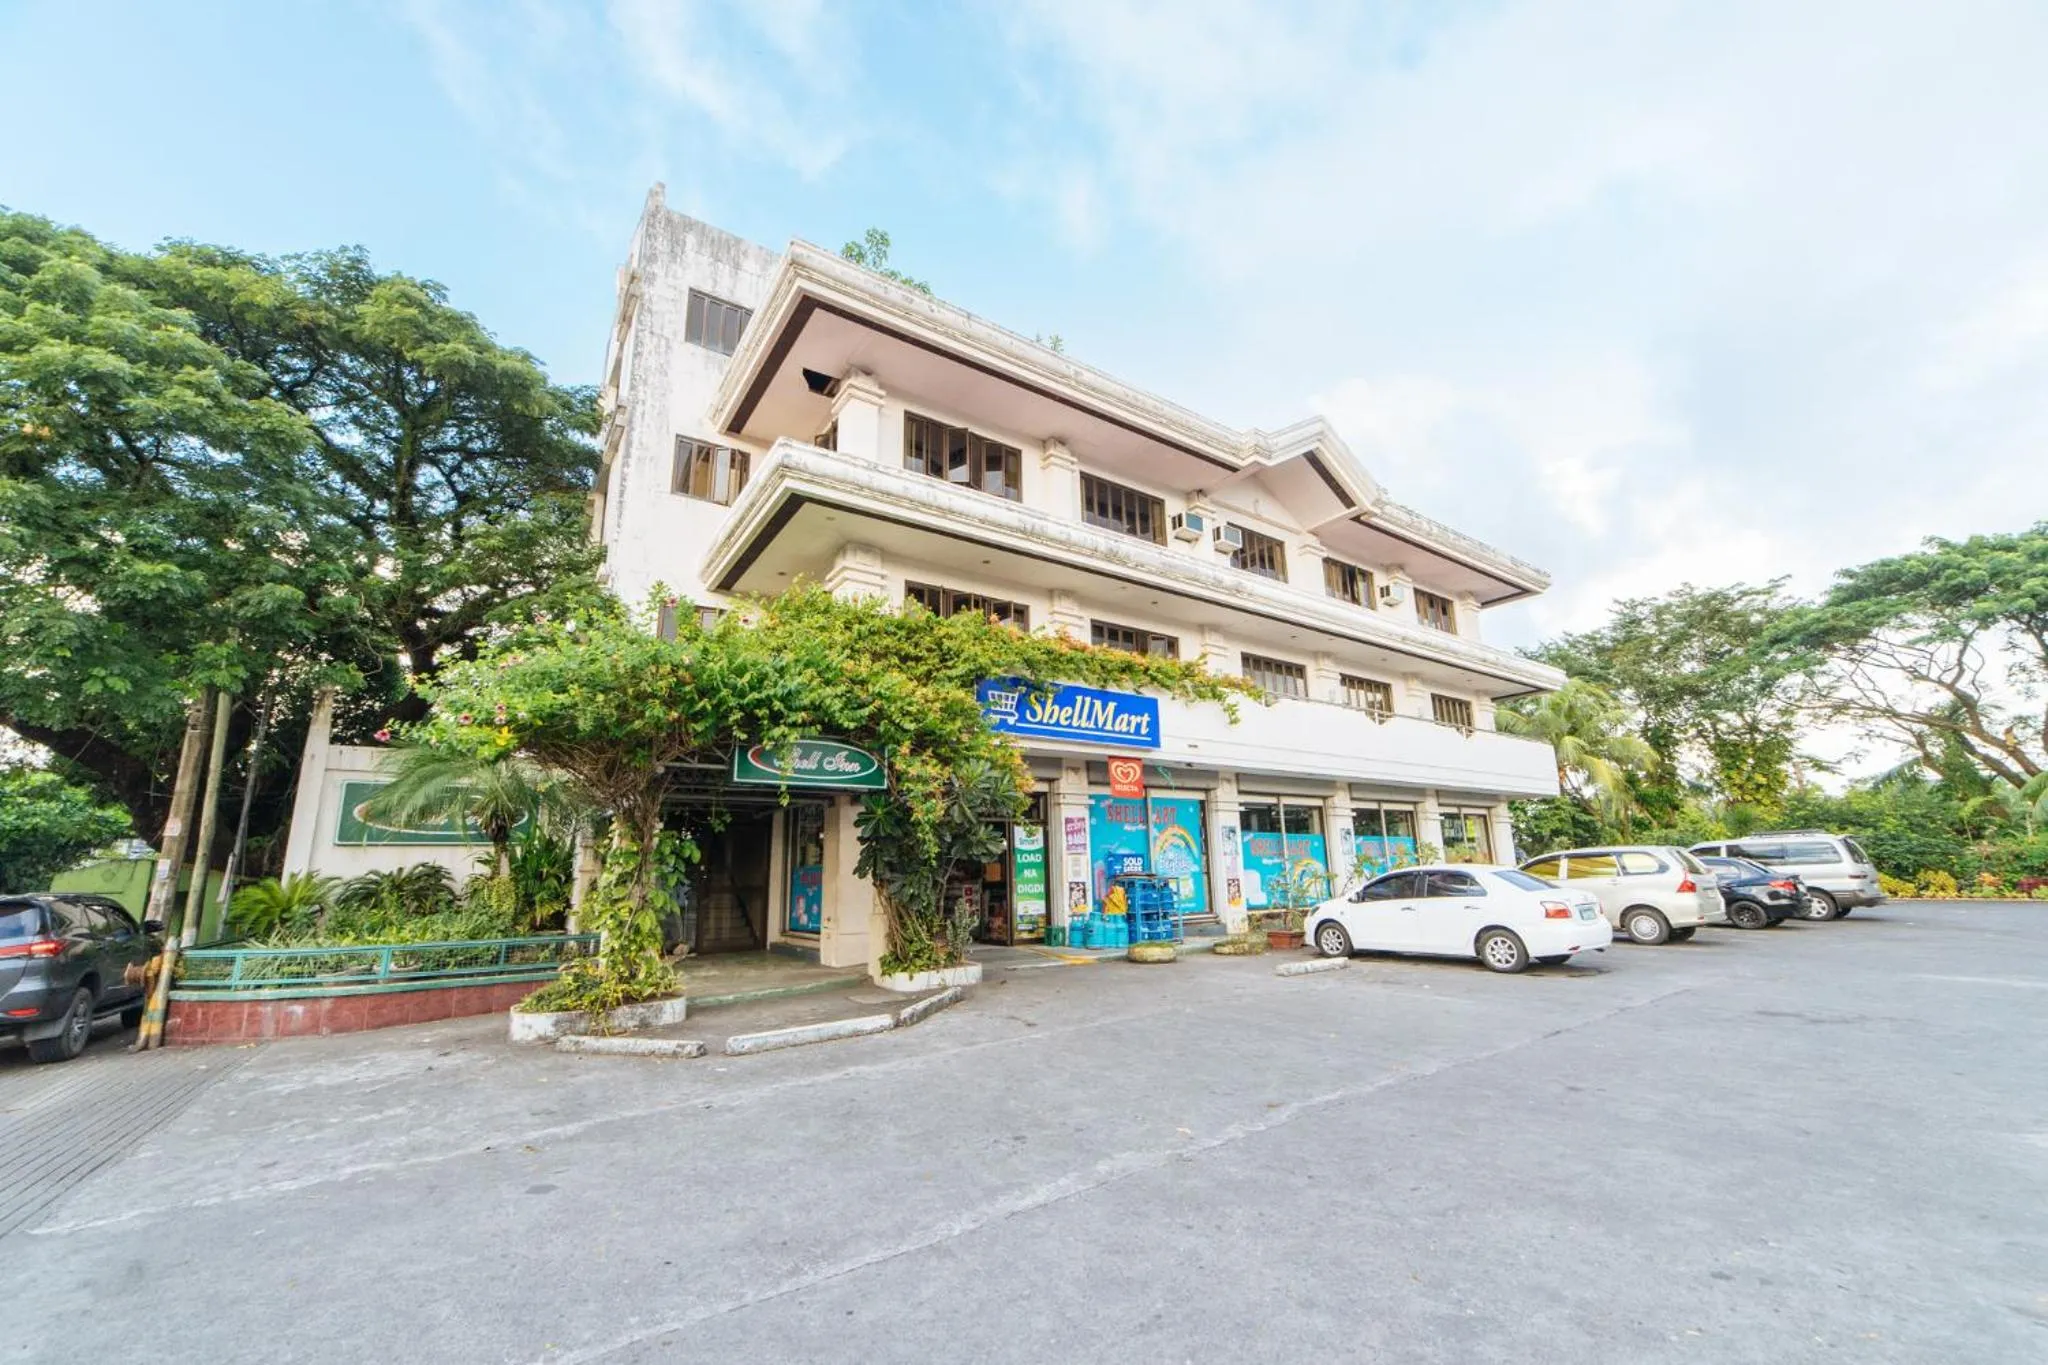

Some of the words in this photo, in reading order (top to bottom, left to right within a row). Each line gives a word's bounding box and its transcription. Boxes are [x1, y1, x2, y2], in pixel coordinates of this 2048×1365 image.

[1025, 692, 1151, 735] ShellMart
[823, 750, 862, 773] Inn
[1017, 853, 1043, 863] LOAD
[1123, 856, 1144, 866] SOLD
[1023, 868, 1038, 878] NA
